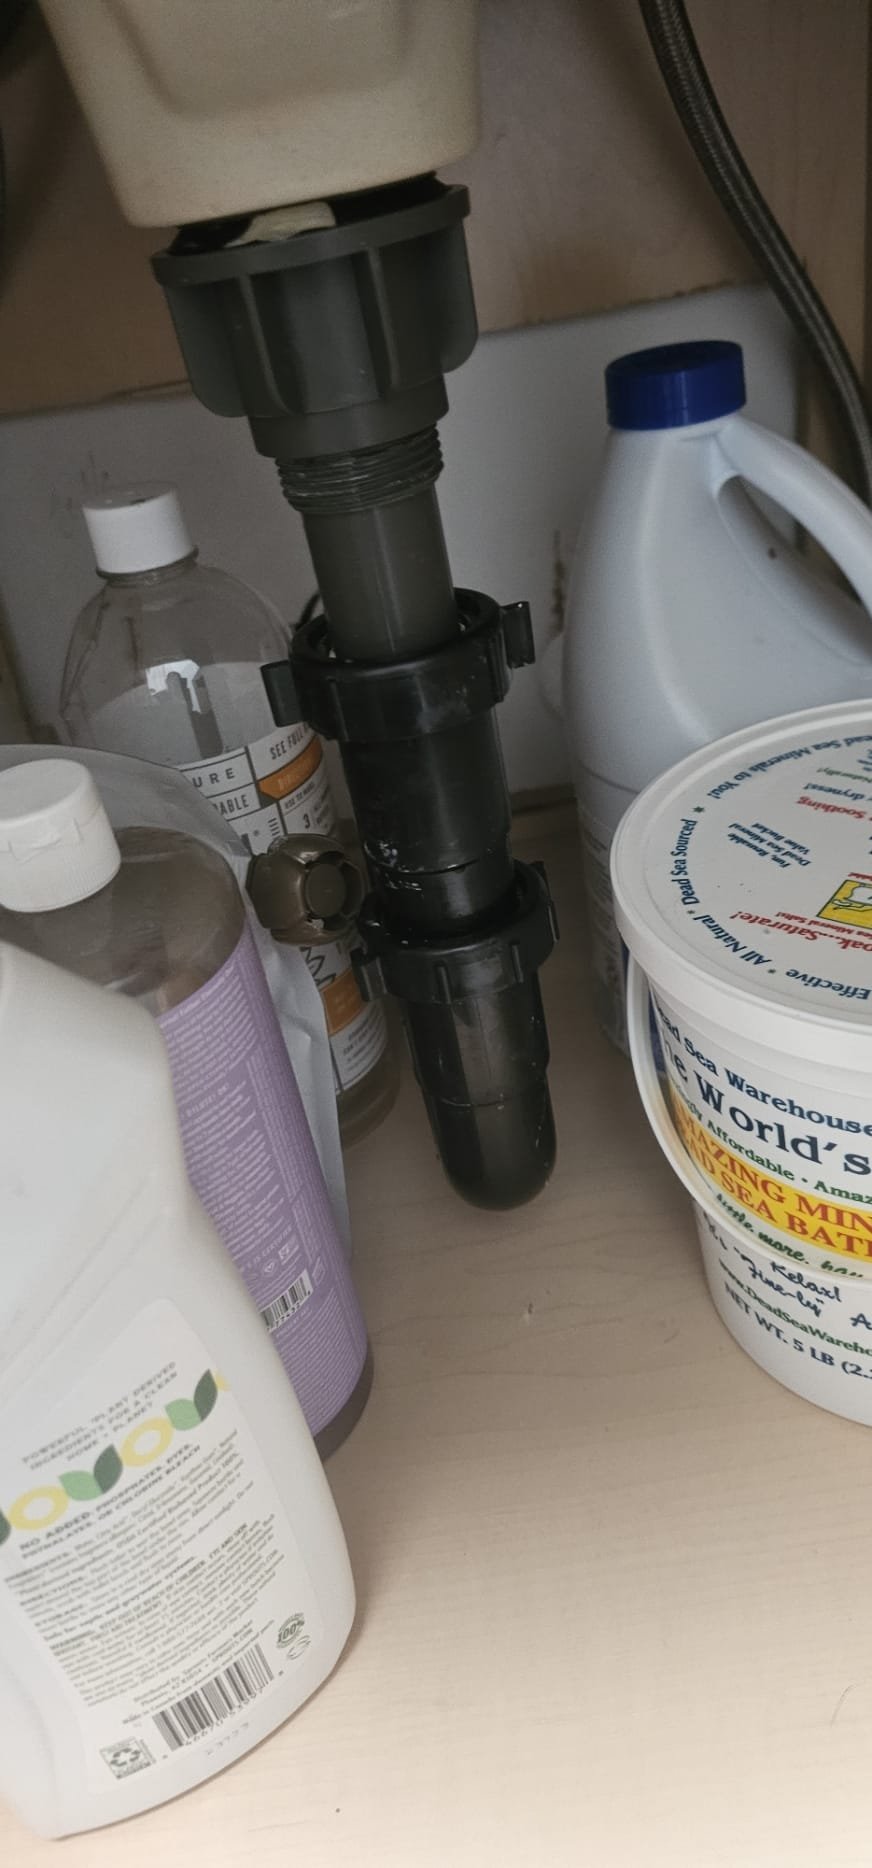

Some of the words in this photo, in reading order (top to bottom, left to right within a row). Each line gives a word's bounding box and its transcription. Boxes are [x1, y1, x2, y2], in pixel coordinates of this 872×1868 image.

[270, 741, 287, 760] SEE
[811, 739, 842, 753] Sea
[748, 747, 813, 773] Minerals
[192, 768, 235, 788] URE
[734, 770, 752, 782] to
[706, 778, 740, 800] You!
[213, 794, 249, 815] ABLE
[795, 796, 867, 820] Soothing
[303, 813, 310, 829] 3
[750, 822, 785, 842] Bucket
[670, 818, 698, 857] Sourced
[727, 823, 767, 845] Mineral
[727, 833, 769, 857] Reusable
[767, 841, 785, 854] Sea
[784, 839, 811, 855] Value
[784, 851, 811, 867] Dead
[670, 859, 688, 876] Sea
[671, 878, 700, 905] Dead
[693, 914, 749, 953] Natural
[741, 951, 773, 966] All
[785, 968, 872, 1001] Effective
[684, 1037, 719, 1077] Sea
[693, 1069, 872, 1176] World's
[707, 1119, 796, 1181] Affordable
[720, 1171, 778, 1223] SEA
[793, 1337, 805, 1353] 5
[809, 1345, 836, 1367] LB
[131, 1359, 177, 1397] DERIVED
[28, 1422, 105, 1470] INGREDIENTS
[106, 1405, 130, 1424] FOR
[132, 1398, 141, 1407] A
[142, 1370, 179, 1400] CLEAN
[65, 1438, 98, 1461] HOME
[111, 1399, 154, 1432] PLANET
[96, 1507, 114, 1521] OR
[113, 1474, 164, 1511] CHLORINE
[163, 1442, 202, 1475] BLEACH
[18, 1536, 41, 1552] NO
